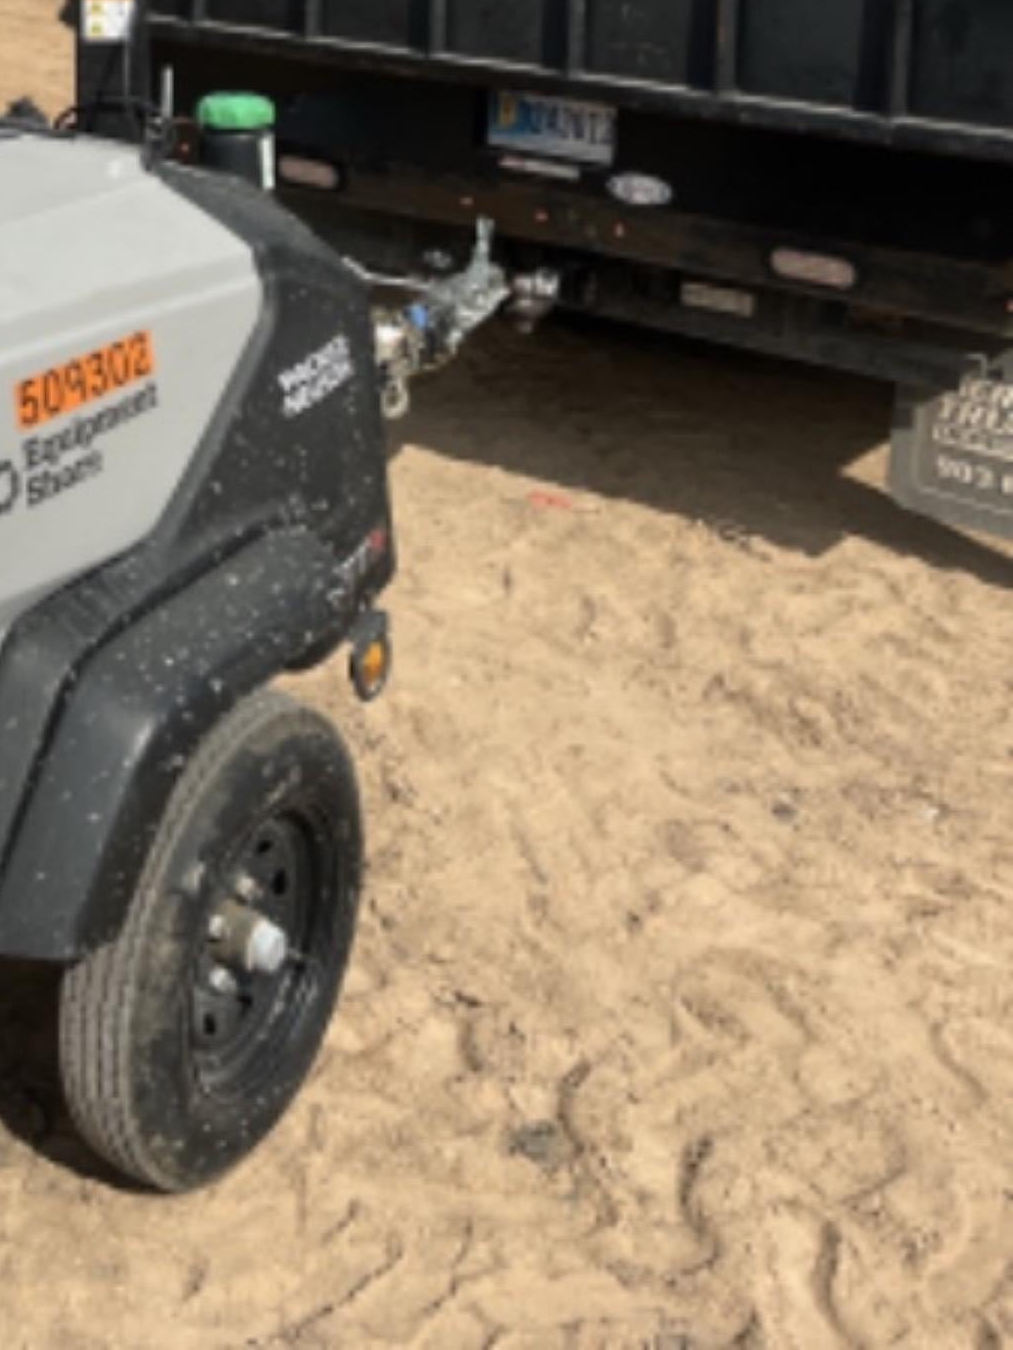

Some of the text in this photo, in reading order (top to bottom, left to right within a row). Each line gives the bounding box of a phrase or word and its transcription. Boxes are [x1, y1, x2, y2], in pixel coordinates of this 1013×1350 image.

[19, 331, 153, 426] 509302
[25, 382, 158, 470] Equipment
[26, 452, 104, 508] Share
